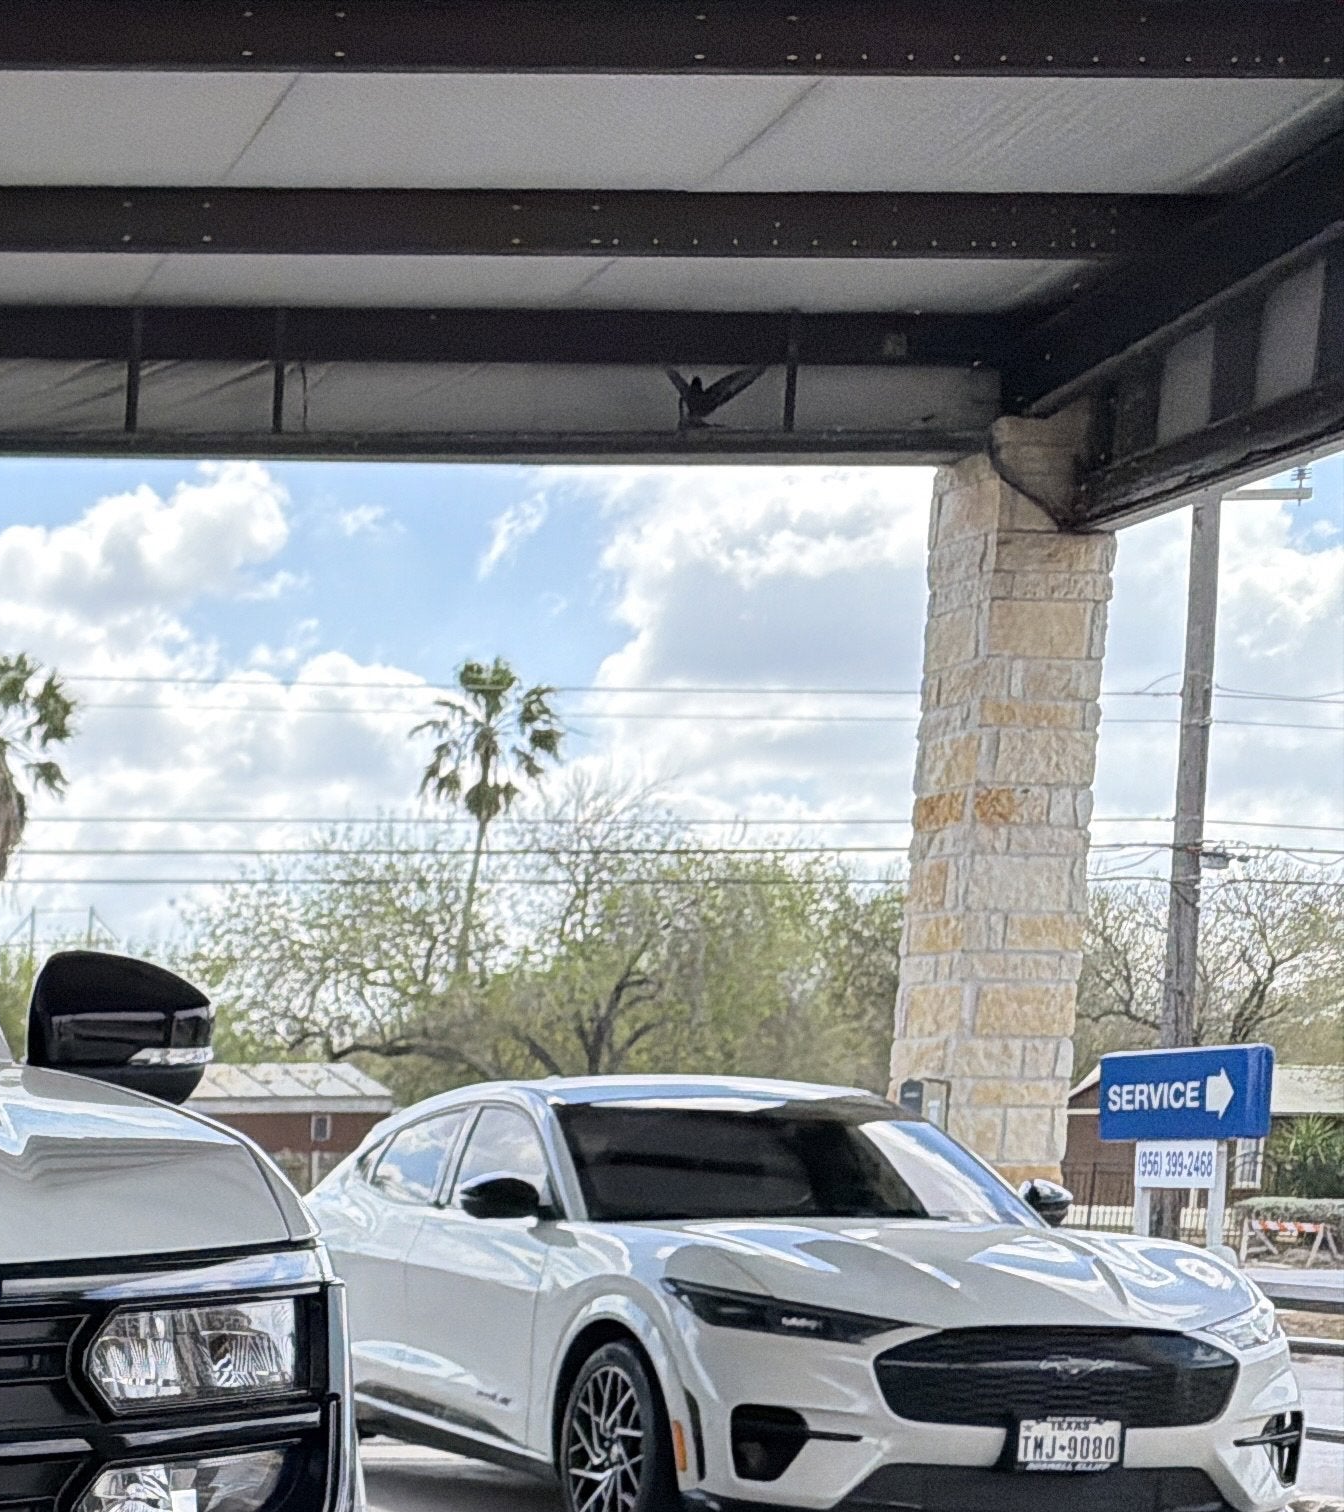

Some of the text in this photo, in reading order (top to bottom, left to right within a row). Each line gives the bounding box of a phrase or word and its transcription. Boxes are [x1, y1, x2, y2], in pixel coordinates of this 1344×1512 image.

[1107, 1080, 1201, 1112] SERVICE
[1137, 1151, 1213, 1178] (956) 399-2468
[1051, 1420, 1090, 1432] TEXAS
